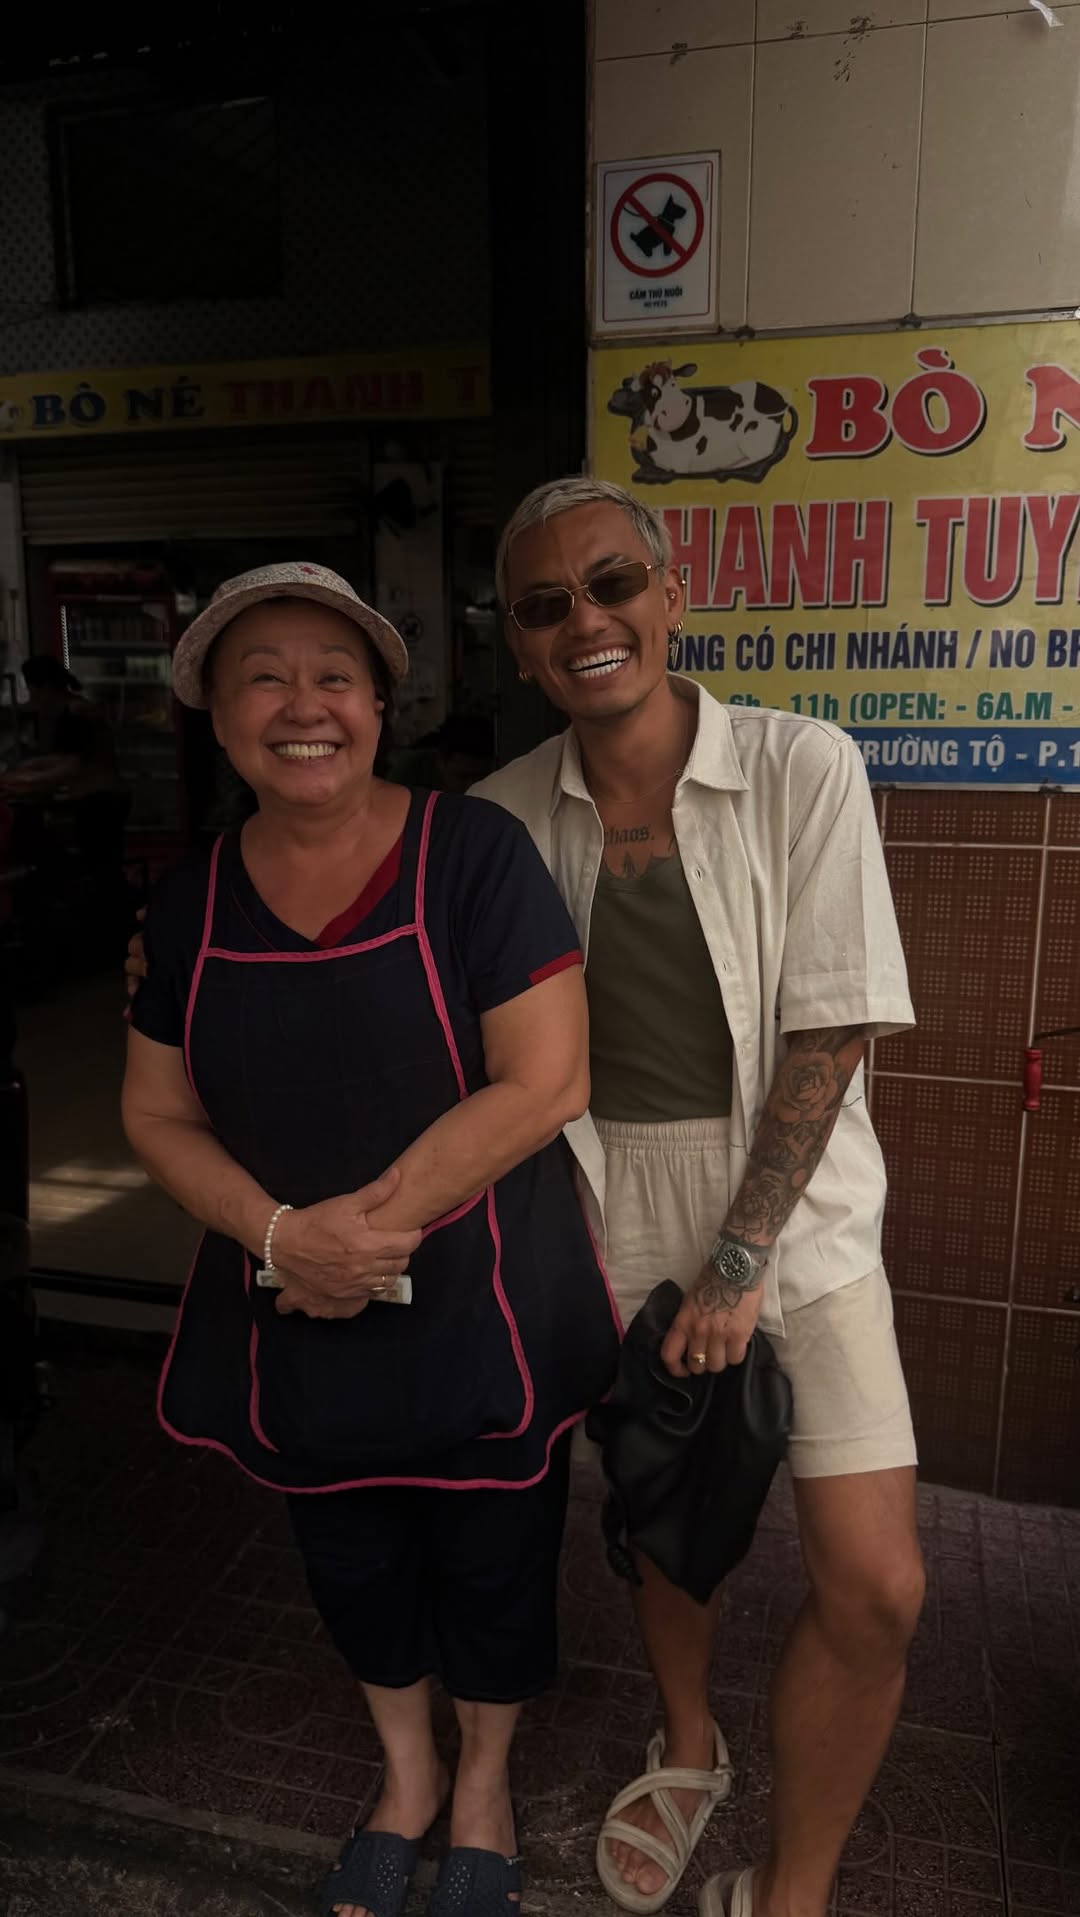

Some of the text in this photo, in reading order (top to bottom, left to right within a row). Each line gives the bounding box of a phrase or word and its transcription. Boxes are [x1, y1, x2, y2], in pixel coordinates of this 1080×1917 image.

[225, 368, 424, 418] THANH
[805, 348, 987, 459] BÒ
[653, 493, 1080, 611] HANH TUY
[735, 625, 775, 671] CÓ
[785, 631, 836, 671] CHI
[846, 622, 959, 669] NHÁNH
[965, 629, 982, 669] /
[989, 629, 1036, 668] NO
[790, 693, 839, 721] 11h
[850, 692, 946, 723] (OPEN:
[976, 691, 1053, 720] 6A.M
[855, 733, 959, 767] RƯỜNG
[968, 733, 1006, 773] TỘ
